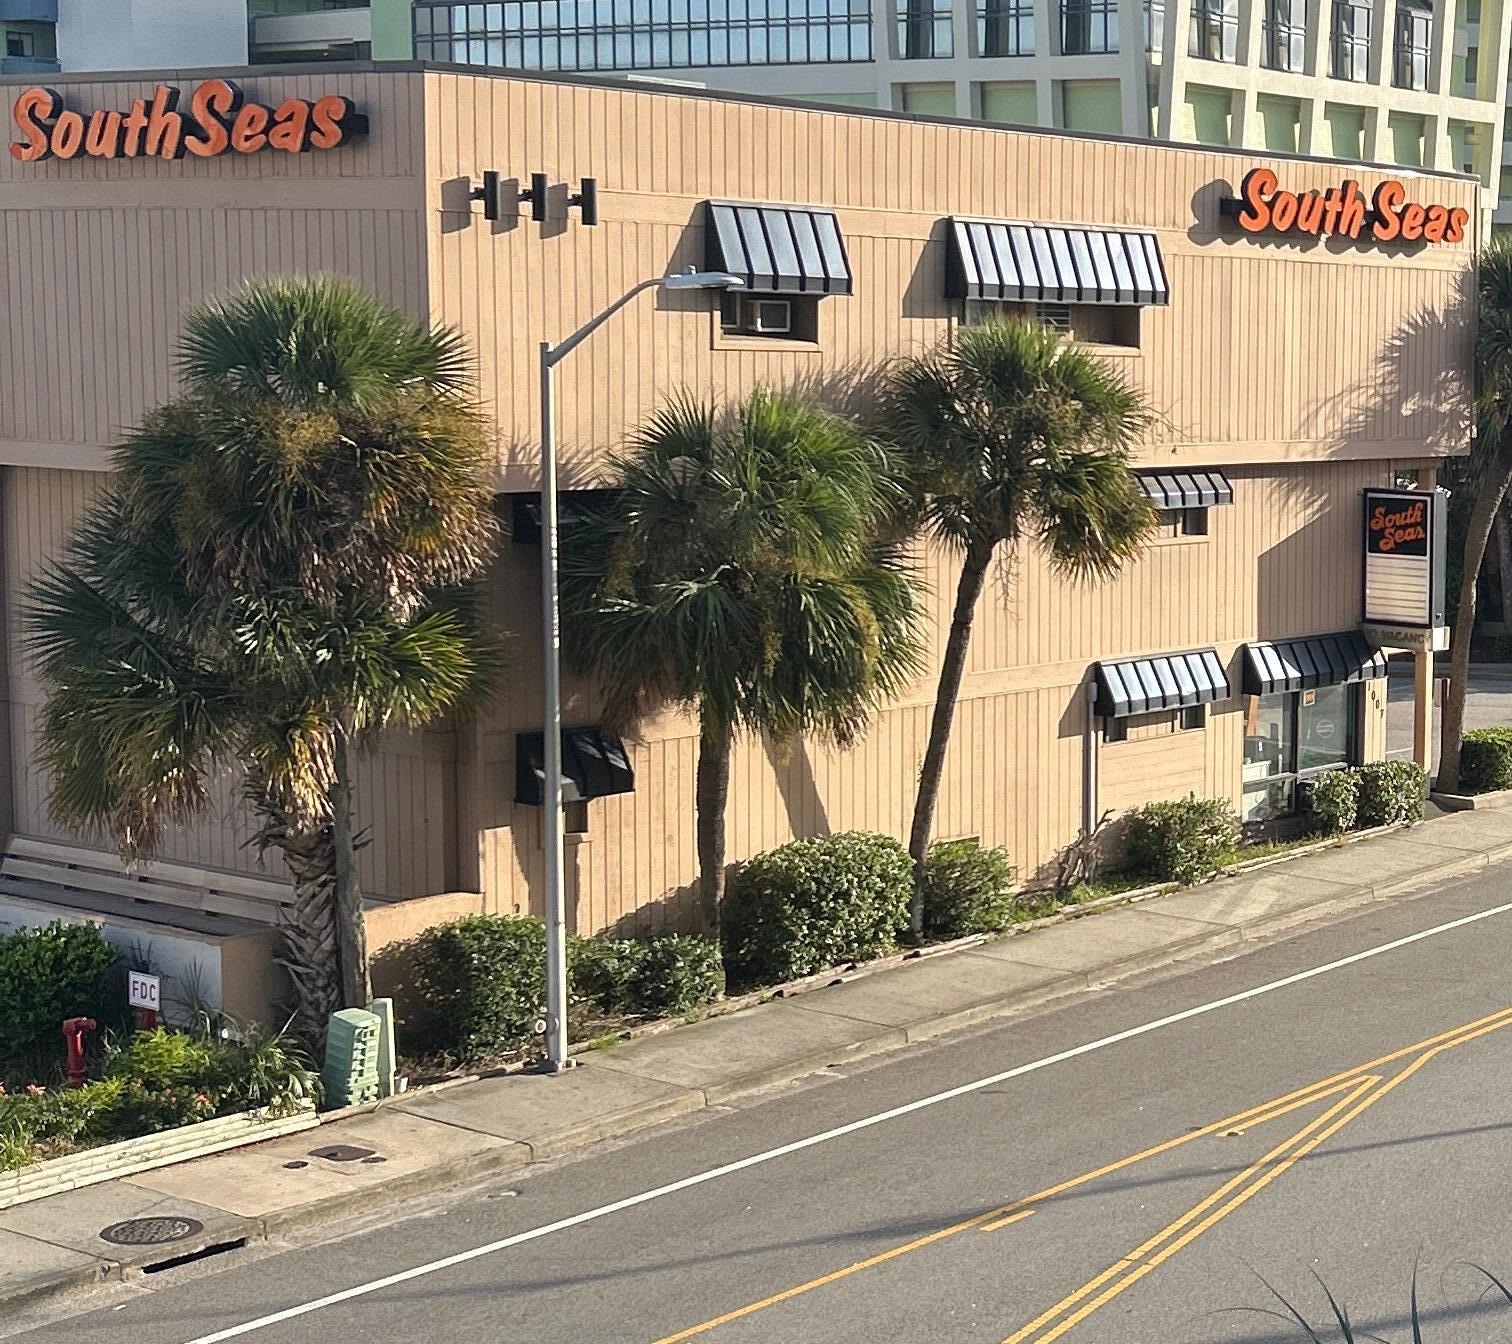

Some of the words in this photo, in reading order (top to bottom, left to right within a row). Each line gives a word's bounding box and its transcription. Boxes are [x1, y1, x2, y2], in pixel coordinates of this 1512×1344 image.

[9, 84, 184, 161] South
[184, 78, 351, 158] Seas
[1238, 167, 1366, 240] South
[1372, 180, 1470, 244] Seas
[1371, 502, 1423, 530] South
[1379, 527, 1425, 550] Seas
[133, 981, 156, 1001] FDC
